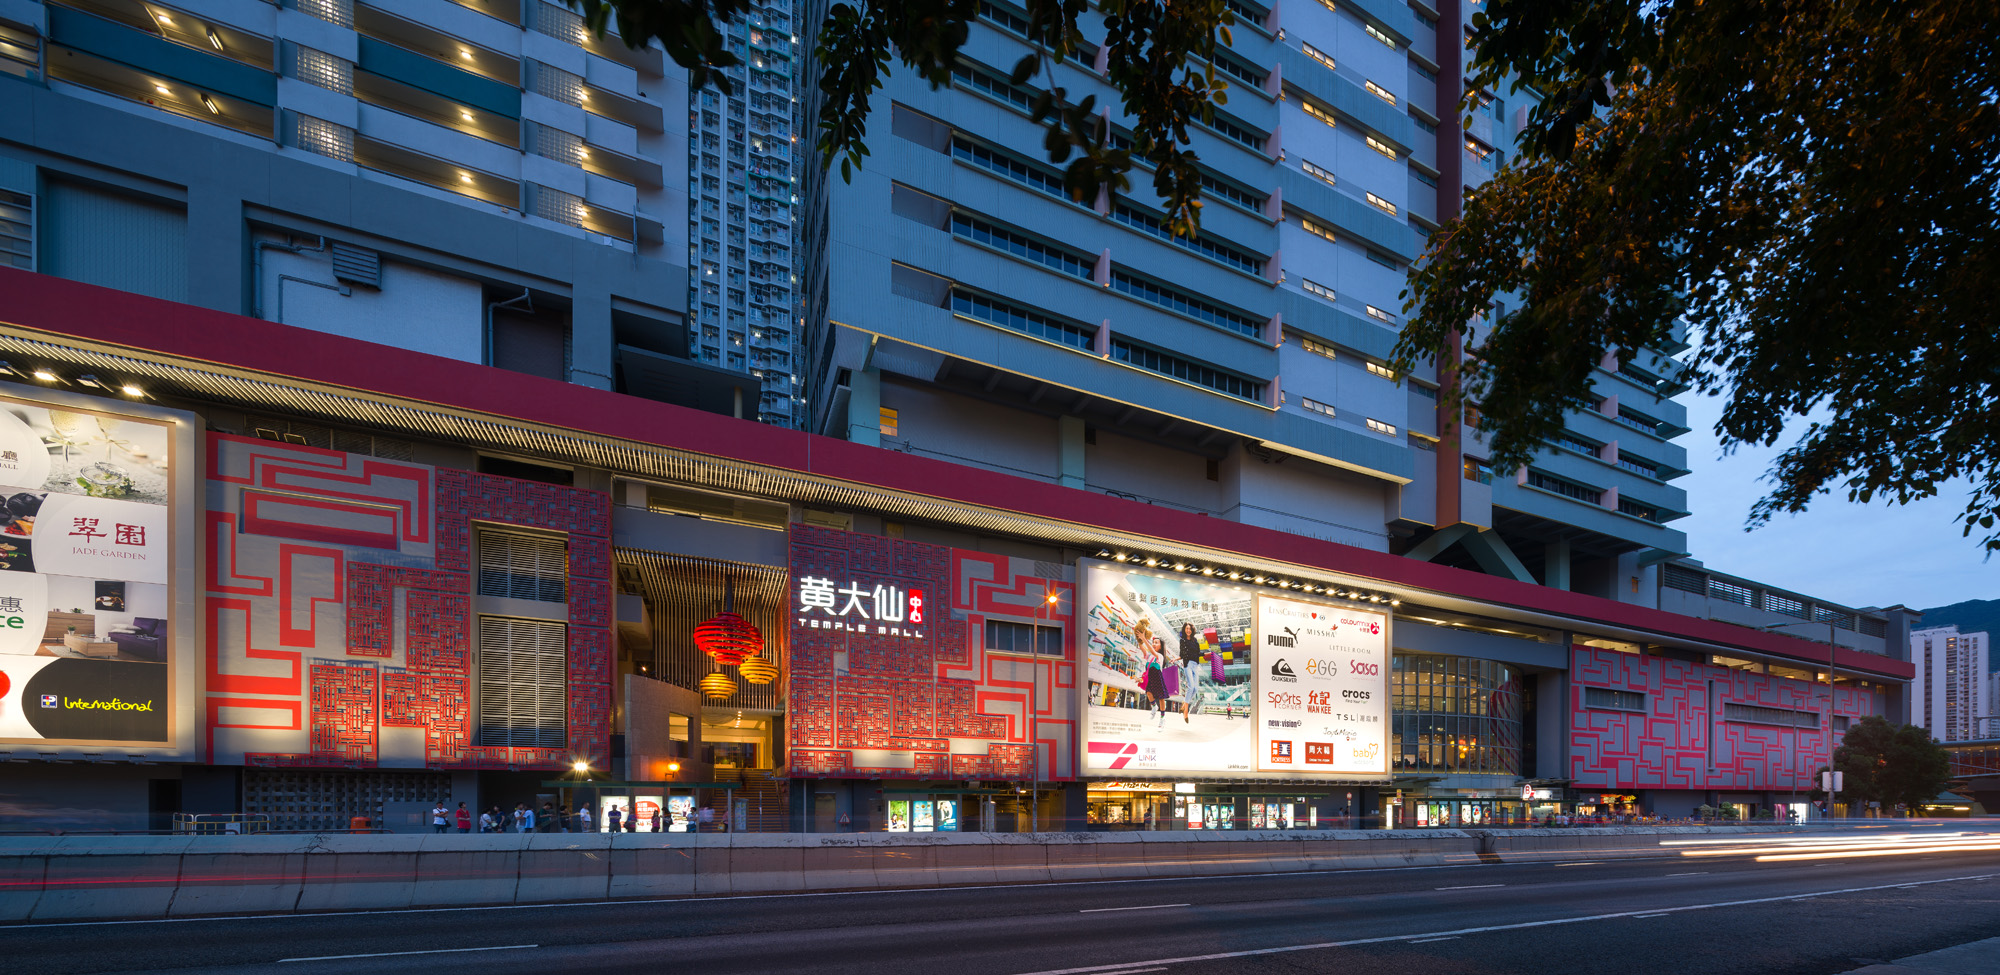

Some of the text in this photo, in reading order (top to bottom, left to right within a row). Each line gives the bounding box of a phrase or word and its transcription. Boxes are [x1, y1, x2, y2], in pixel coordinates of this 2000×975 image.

[73, 546, 146, 561] JADE GARDEN
[909, 595, 922, 623] 中心
[798, 618, 923, 638] TEMPLE MALL
[1306, 628, 1336, 638] MISSHA
[1267, 634, 1294, 649] PUMA
[1271, 676, 1298, 684] QUIKSILVER
[1267, 691, 1302, 709] Sports
[1308, 689, 1331, 706] 允記
[1341, 689, 1371, 700] crocs
[64, 696, 153, 711] International
[1307, 705, 1332, 715] WAN KEE
[1336, 713, 1355, 722] TSL
[1138, 754, 1157, 762] LINK
[1353, 746, 1377, 759] baby
